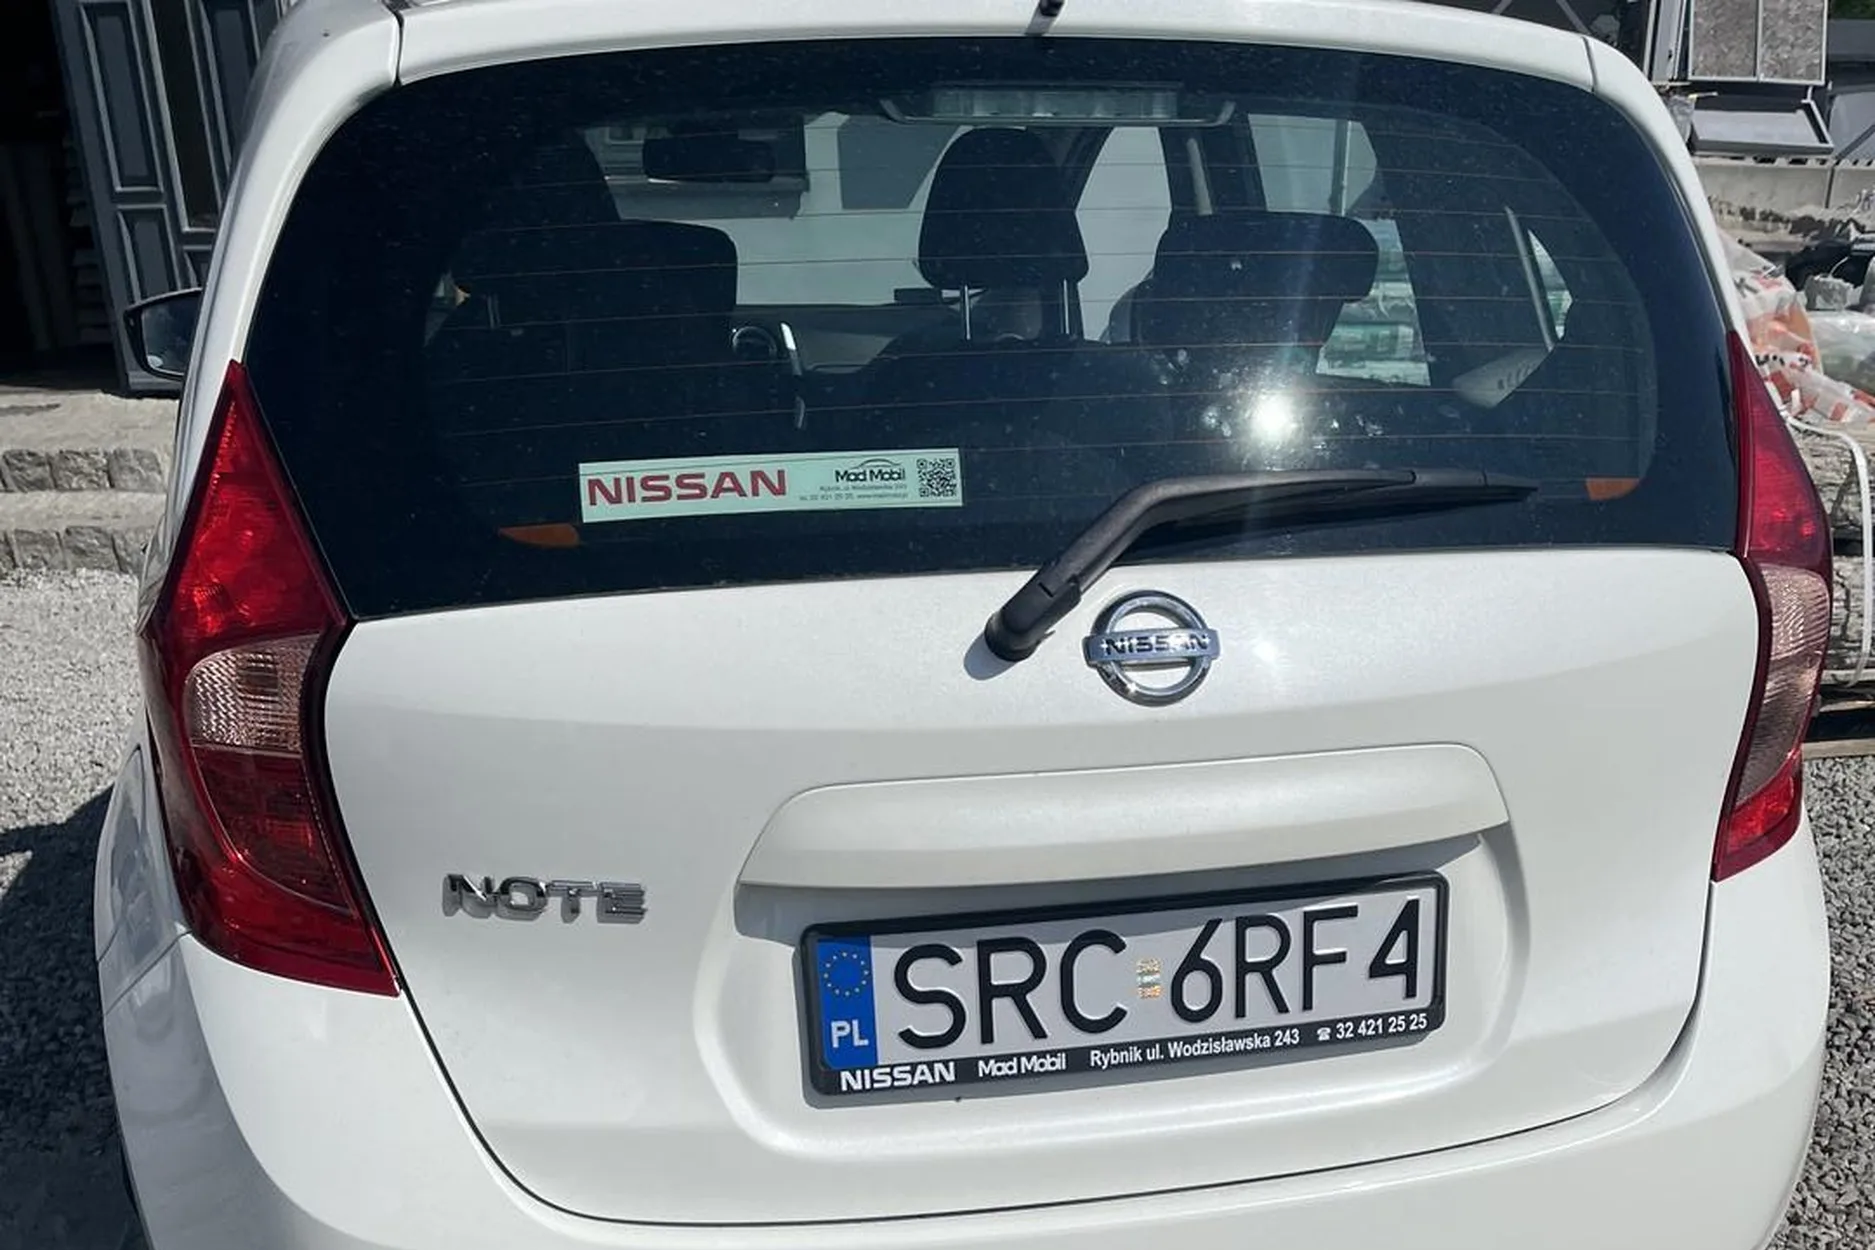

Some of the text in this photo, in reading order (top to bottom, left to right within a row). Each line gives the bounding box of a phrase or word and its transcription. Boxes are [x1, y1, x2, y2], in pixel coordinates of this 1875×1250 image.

[587, 469, 786, 506] NISSAN
[834, 468, 906, 482] Mad Mobil
[441, 873, 648, 925] NOTE
[893, 897, 1420, 1050] SRC 6RF4
[831, 1019, 869, 1049] PL
[1336, 1013, 1428, 1040] 32 421 25 25
[1090, 1028, 1300, 1070] Rybnik ul. Wodzisławska 243
[840, 1061, 956, 1092] NISSAN
[978, 1053, 1066, 1078] Mad Mobil
